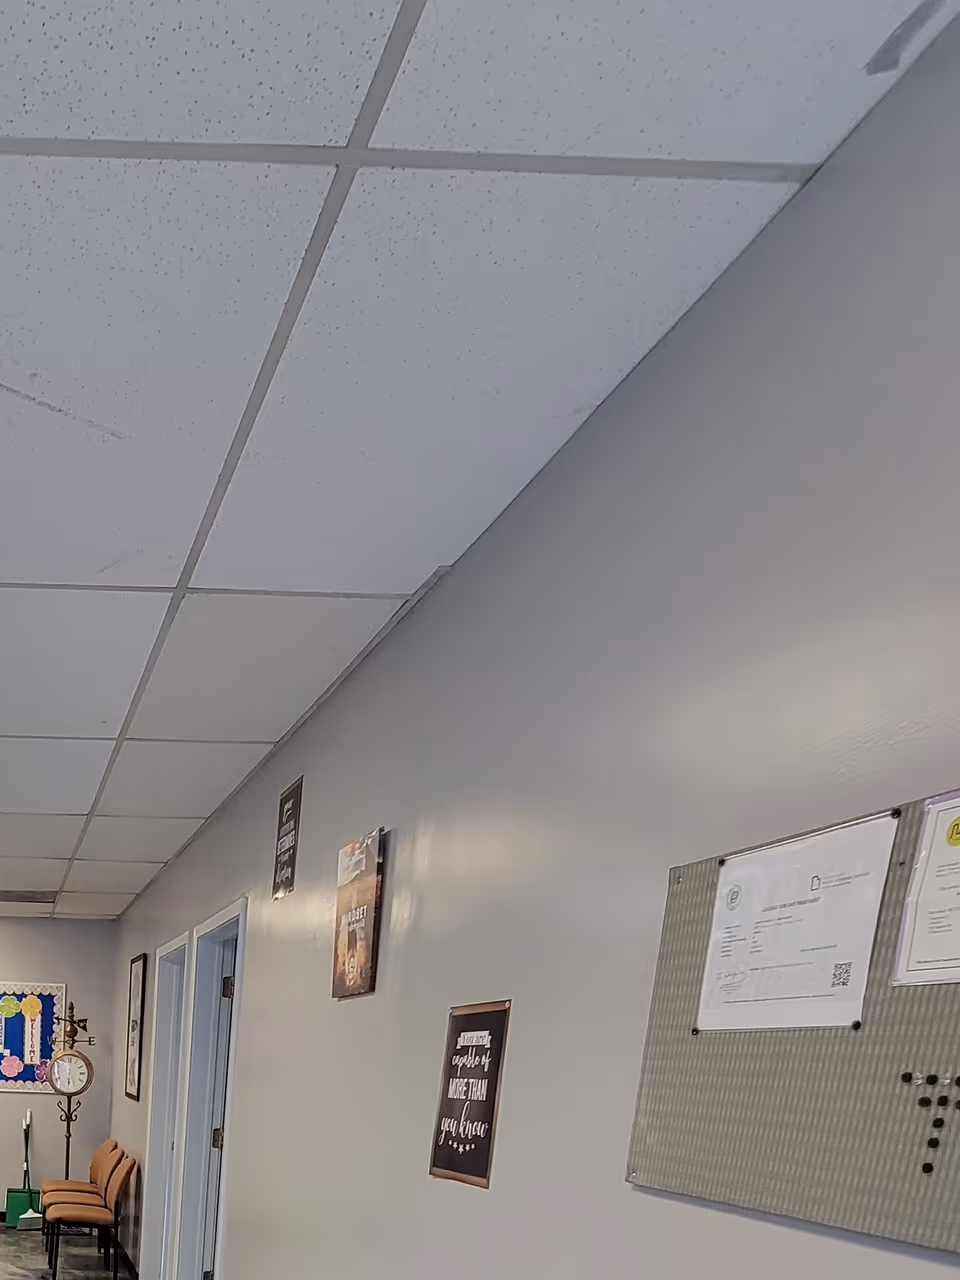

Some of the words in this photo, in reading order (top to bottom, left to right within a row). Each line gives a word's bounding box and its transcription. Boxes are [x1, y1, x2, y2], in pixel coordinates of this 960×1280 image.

[88, 1036, 96, 1046] E
[451, 1047, 480, 1076] capable
[481, 1048, 492, 1072] of
[448, 1077, 467, 1100] MORE
[468, 1078, 487, 1101] THAN
[438, 1115, 458, 1145] you
[458, 1101, 489, 1139] know
